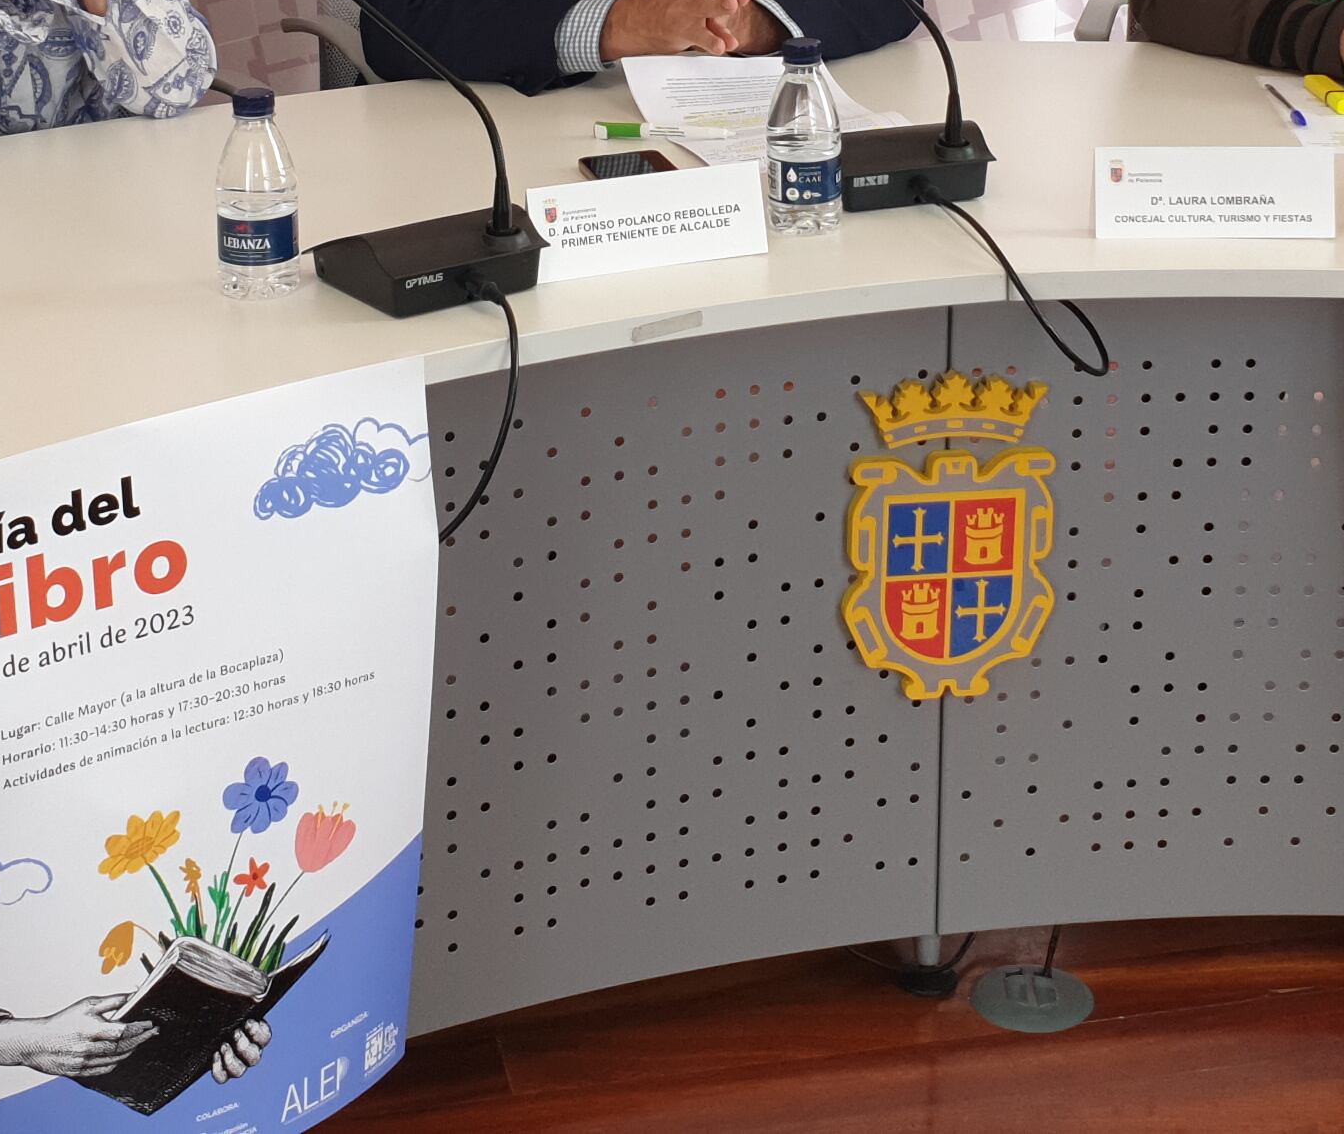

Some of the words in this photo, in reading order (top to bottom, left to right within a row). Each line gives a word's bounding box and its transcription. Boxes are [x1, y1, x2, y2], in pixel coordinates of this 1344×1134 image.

[1169, 196, 1206, 205] LAURA
[1211, 194, 1275, 205] LOMBRAÑA
[548, 228, 559, 237] D.
[563, 220, 614, 235] ALFONSO
[618, 213, 671, 227] POLANCO
[674, 204, 741, 220] REBOLLEDA
[561, 235, 603, 248] PRIMER
[606, 227, 658, 242] TENIENTE
[662, 223, 676, 234] DE
[680, 218, 731, 232] ALCALDE
[1115, 215, 1165, 223] CONCEJAL
[223, 236, 271, 249] LEBANZA
[406, 272, 443, 289] OPTIMUS
[52, 476, 140, 536] del
[2, 654, 30, 678] de
[38, 632, 91, 666] abril
[100, 626, 127, 648] de
[135, 605, 195, 639] 2023
[1, 722, 41, 741] Lugar:
[45, 711, 74, 727] Calle
[78, 698, 117, 718] Mayor
[120, 691, 132, 707] (a
[136, 689, 146, 699] la
[150, 678, 185, 695] altura
[189, 673, 203, 686] de
[206, 669, 216, 680] la
[220, 649, 284, 676] Bocaplaza)
[2, 743, 55, 765] Horario:
[59, 718, 127, 749] 11:30-14:30
[130, 710, 163, 726] horas
[168, 706, 175, 718] y
[178, 683, 250, 712] 17:30-20:30
[254, 675, 286, 692] horas
[4, 761, 76, 789] Actividades
[79, 755, 93, 768] de
[97, 737, 157, 762] animación
[161, 734, 167, 742] a
[172, 729, 181, 740] la
[185, 715, 230, 736] lectura:
[233, 704, 264, 722] 12:30
[268, 694, 299, 712] horas
[302, 693, 309, 703] y
[312, 680, 341, 698] 18:30
[344, 671, 375, 688] horas
